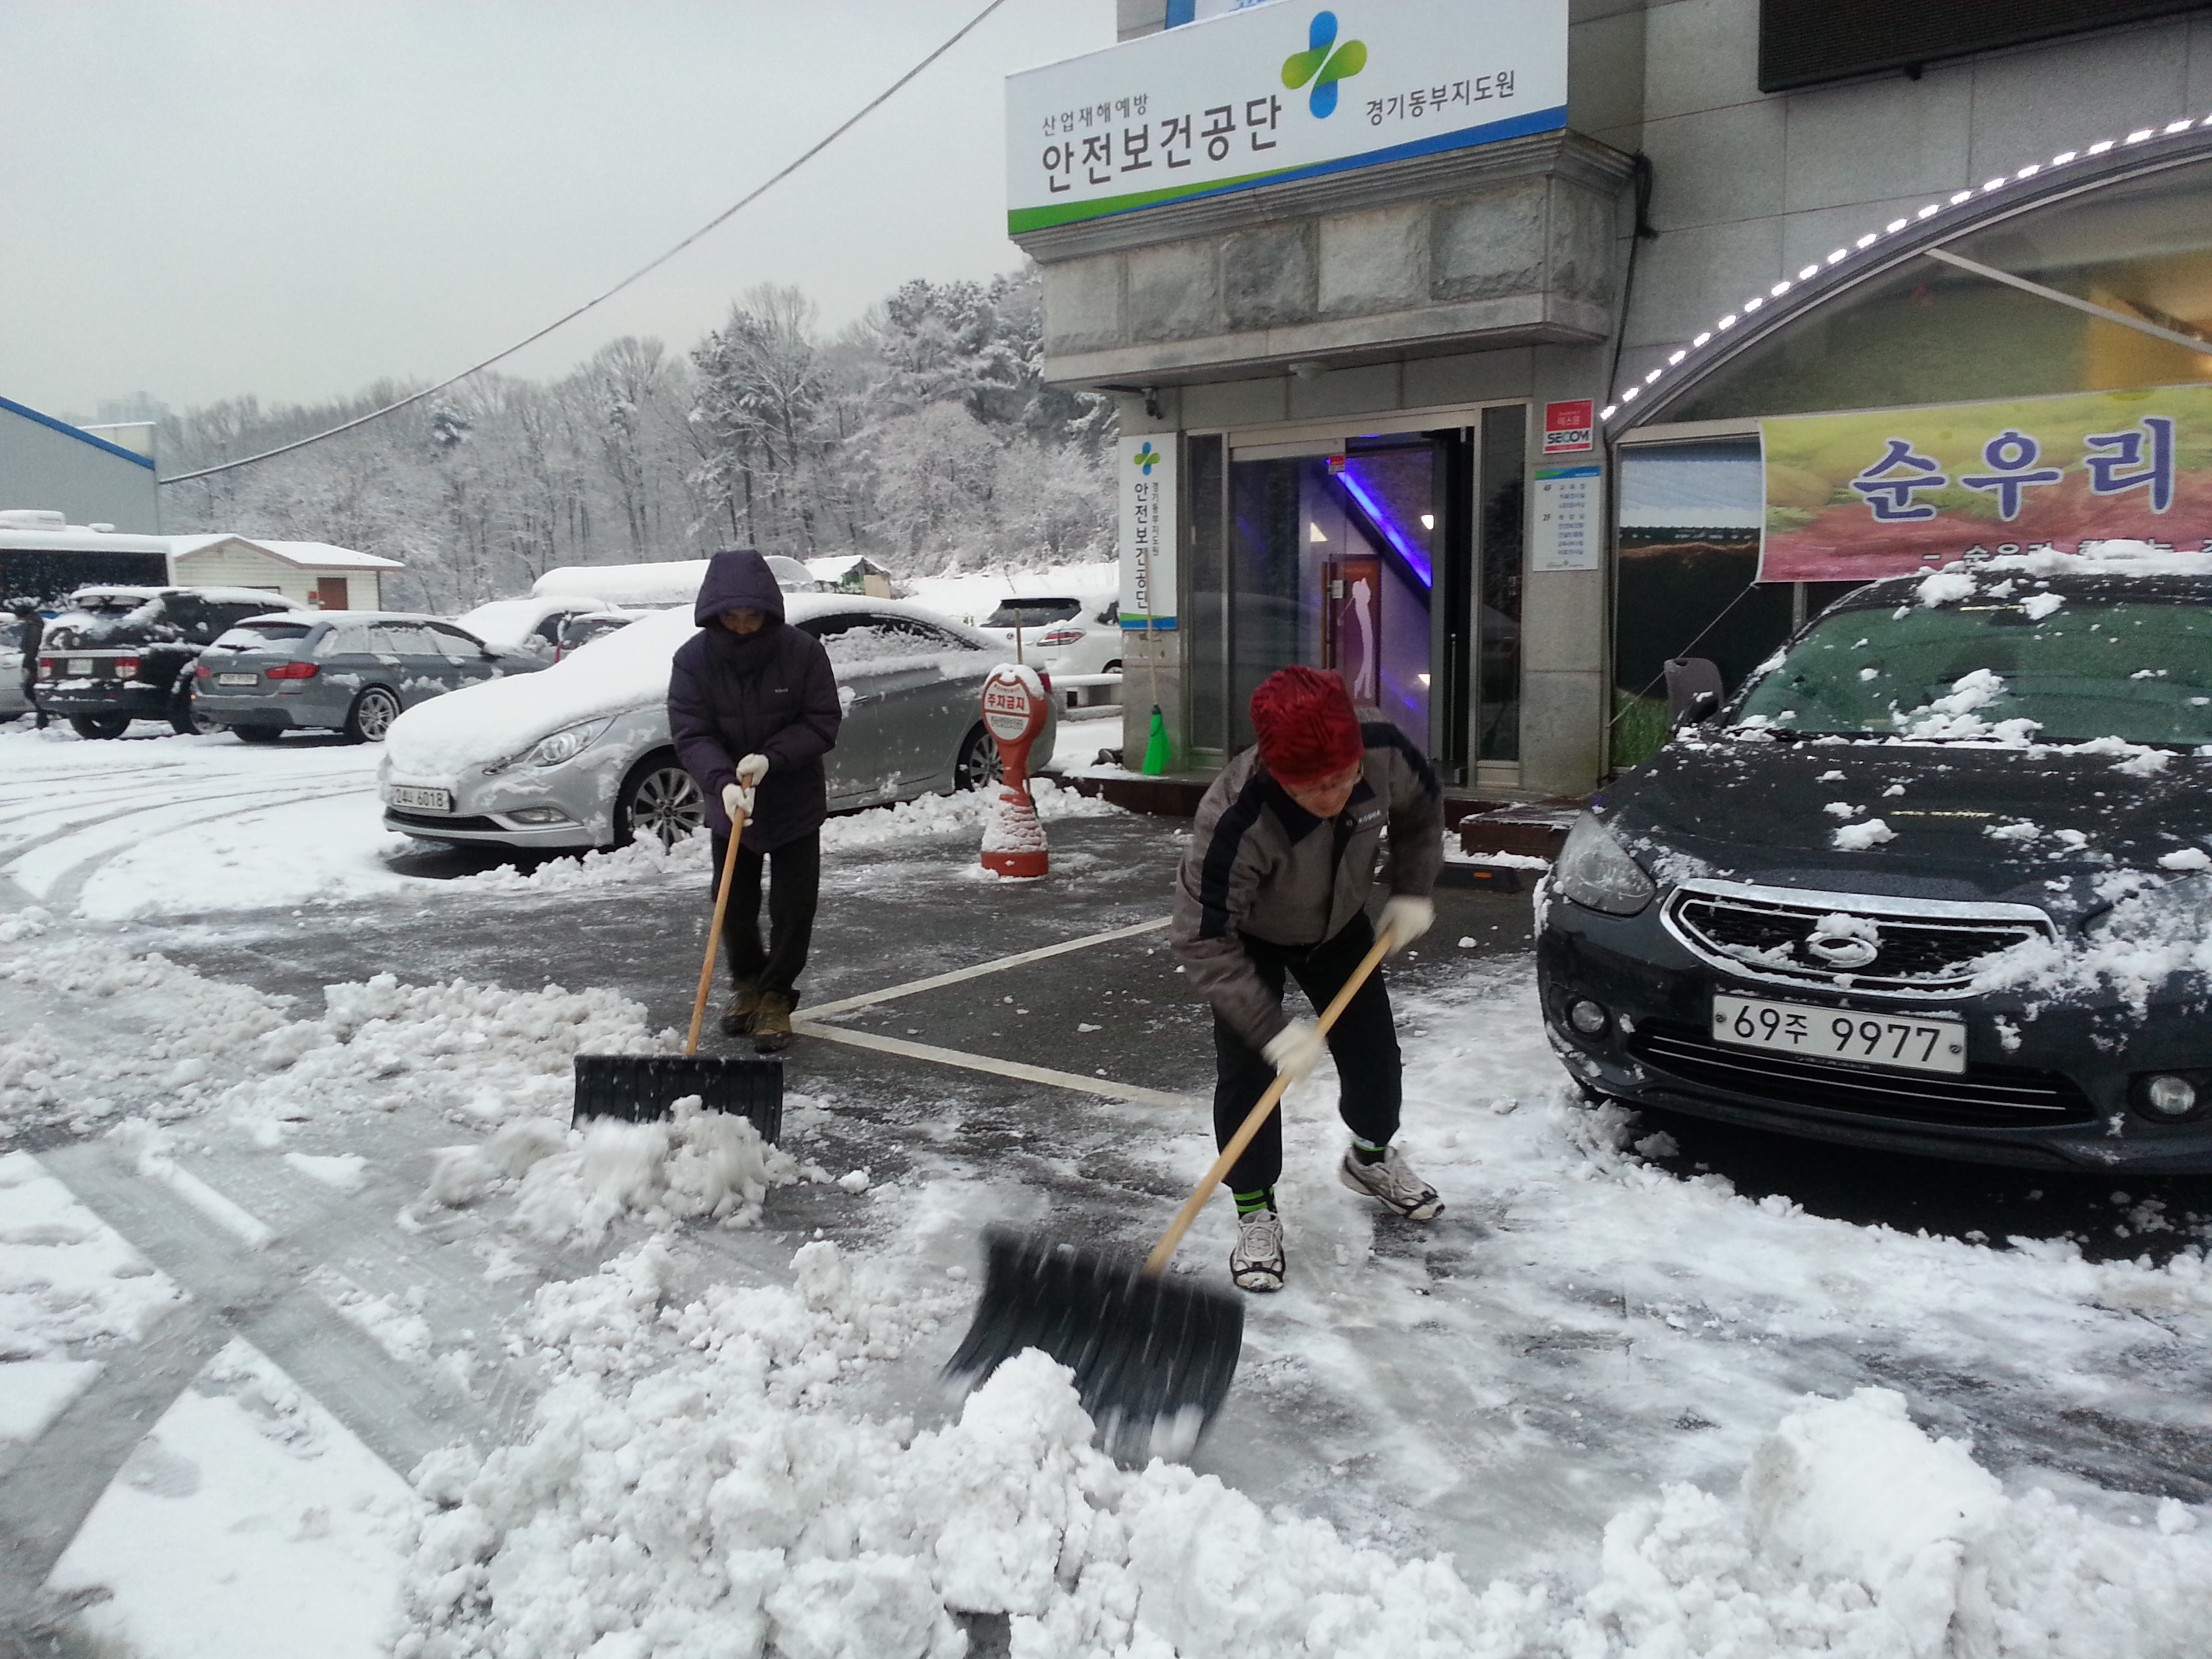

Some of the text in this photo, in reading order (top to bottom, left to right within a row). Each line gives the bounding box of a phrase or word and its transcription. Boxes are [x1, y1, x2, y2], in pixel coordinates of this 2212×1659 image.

[1042, 93, 1149, 136] 산업재해예방
[1366, 70, 1515, 126] 경기동부지도원
[1042, 94, 1282, 193] 안전보건공단
[1547, 430, 1589, 444] SECOM
[1850, 414, 2176, 523] 순우리
[417, 791, 443, 807] 6018
[1733, 1005, 1941, 1062] 69주 9977
